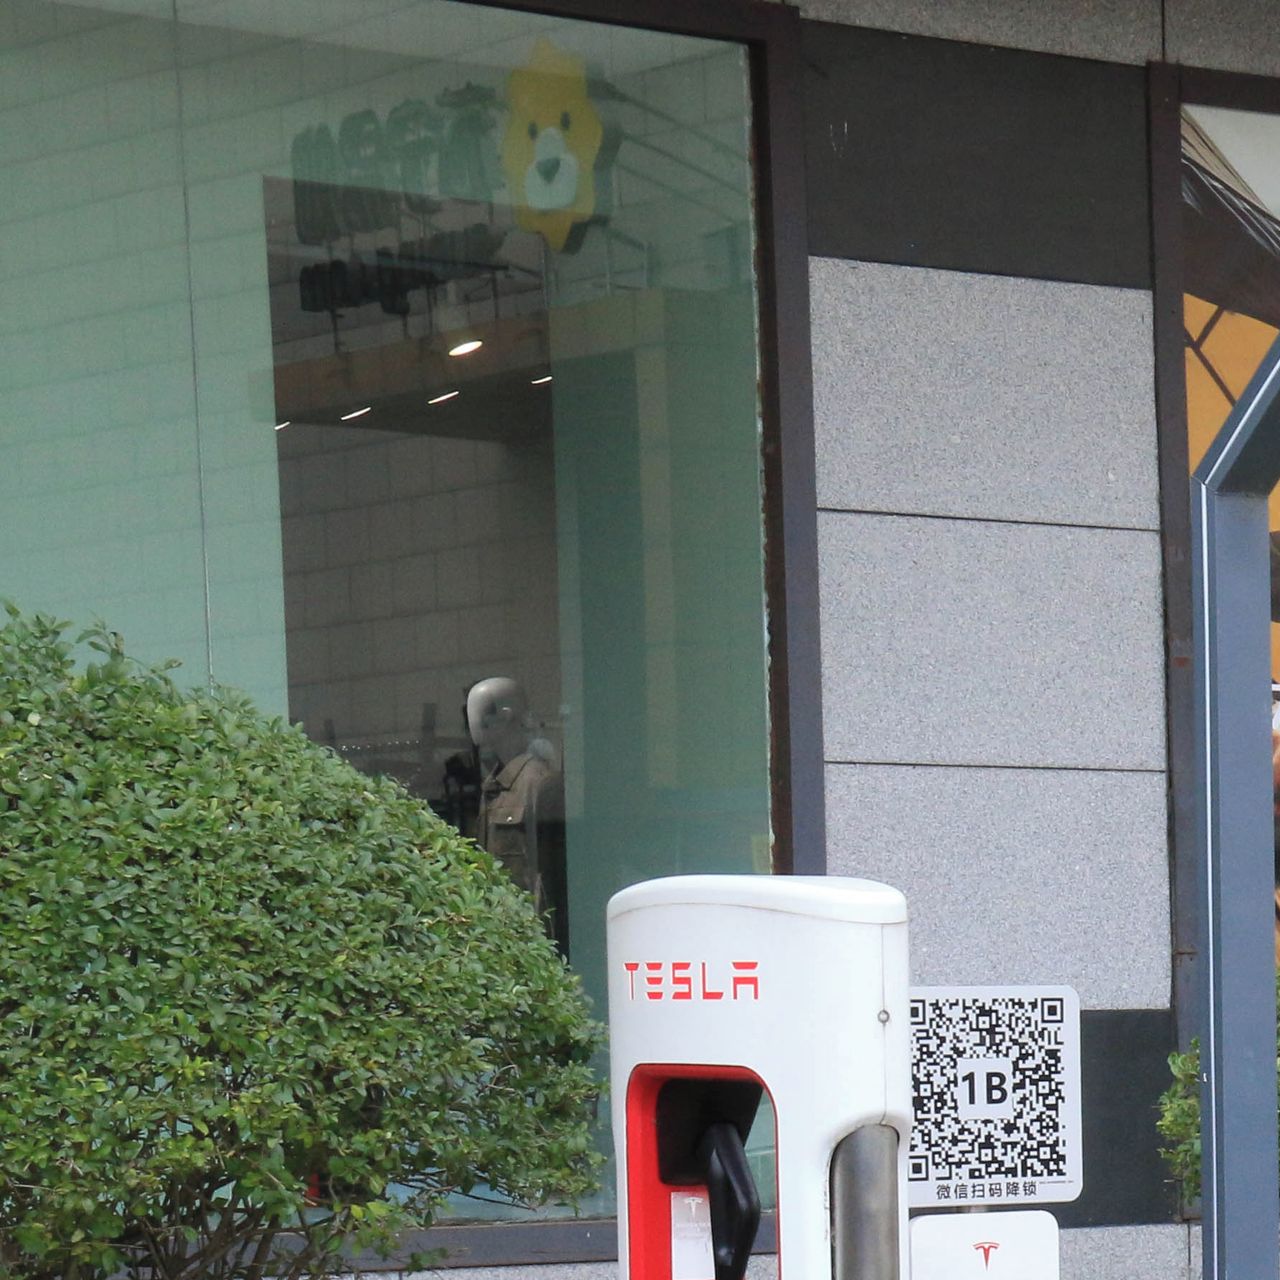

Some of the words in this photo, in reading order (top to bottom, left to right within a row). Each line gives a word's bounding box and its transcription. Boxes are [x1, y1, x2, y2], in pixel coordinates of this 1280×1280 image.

[623, 961, 760, 1001] TESLA
[961, 1070, 1009, 1107] 1B
[936, 1181, 1037, 1200] 微信扫码降锁
